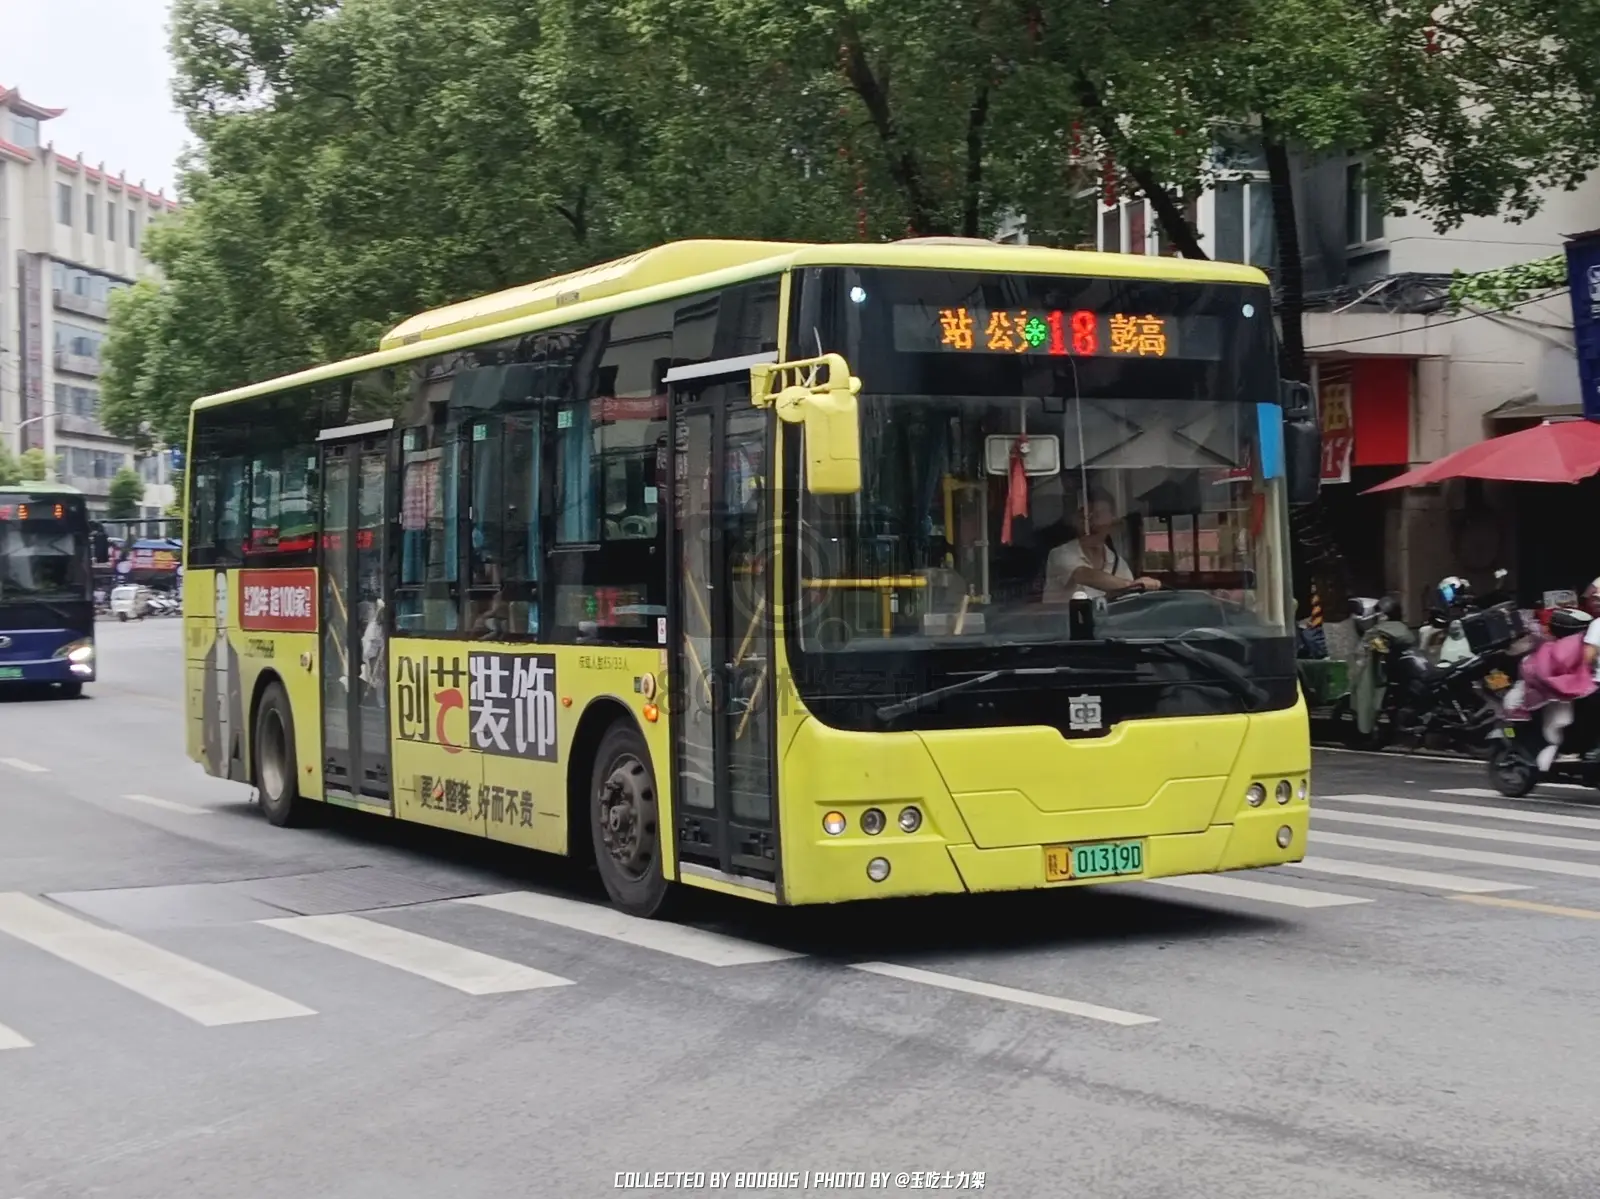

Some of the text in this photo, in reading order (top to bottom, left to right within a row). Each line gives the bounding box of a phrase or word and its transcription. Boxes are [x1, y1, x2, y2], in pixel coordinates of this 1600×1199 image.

[938, 307, 973, 350] 站
[1047, 309, 1099, 356] 18
[1109, 312, 1167, 357] 彭高
[396, 655, 556, 757] 创艺装饰
[474, 783, 534, 829] 好而不贵
[1077, 845, 1141, 874] 01319D
